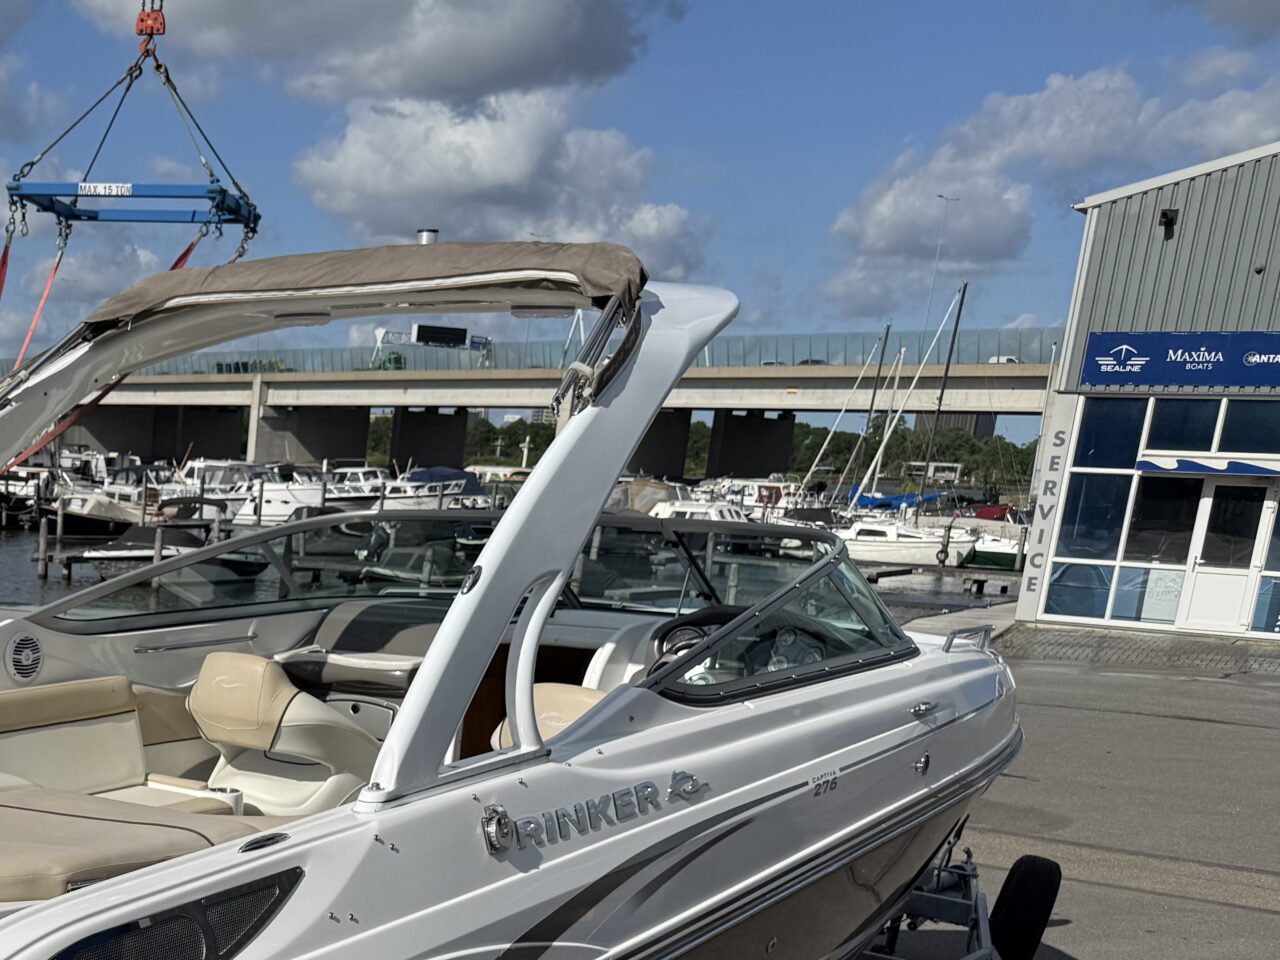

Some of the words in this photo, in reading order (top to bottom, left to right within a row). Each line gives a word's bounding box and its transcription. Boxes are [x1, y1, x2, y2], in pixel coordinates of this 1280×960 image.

[80, 184, 100, 195] MAX.
[104, 185, 113, 195] 15
[116, 185, 131, 196] TON
[1166, 347, 1223, 361] MAXIMA
[1026, 430, 1066, 592] SERVICE
[814, 776, 838, 797] 276
[515, 780, 662, 850] RINKER
